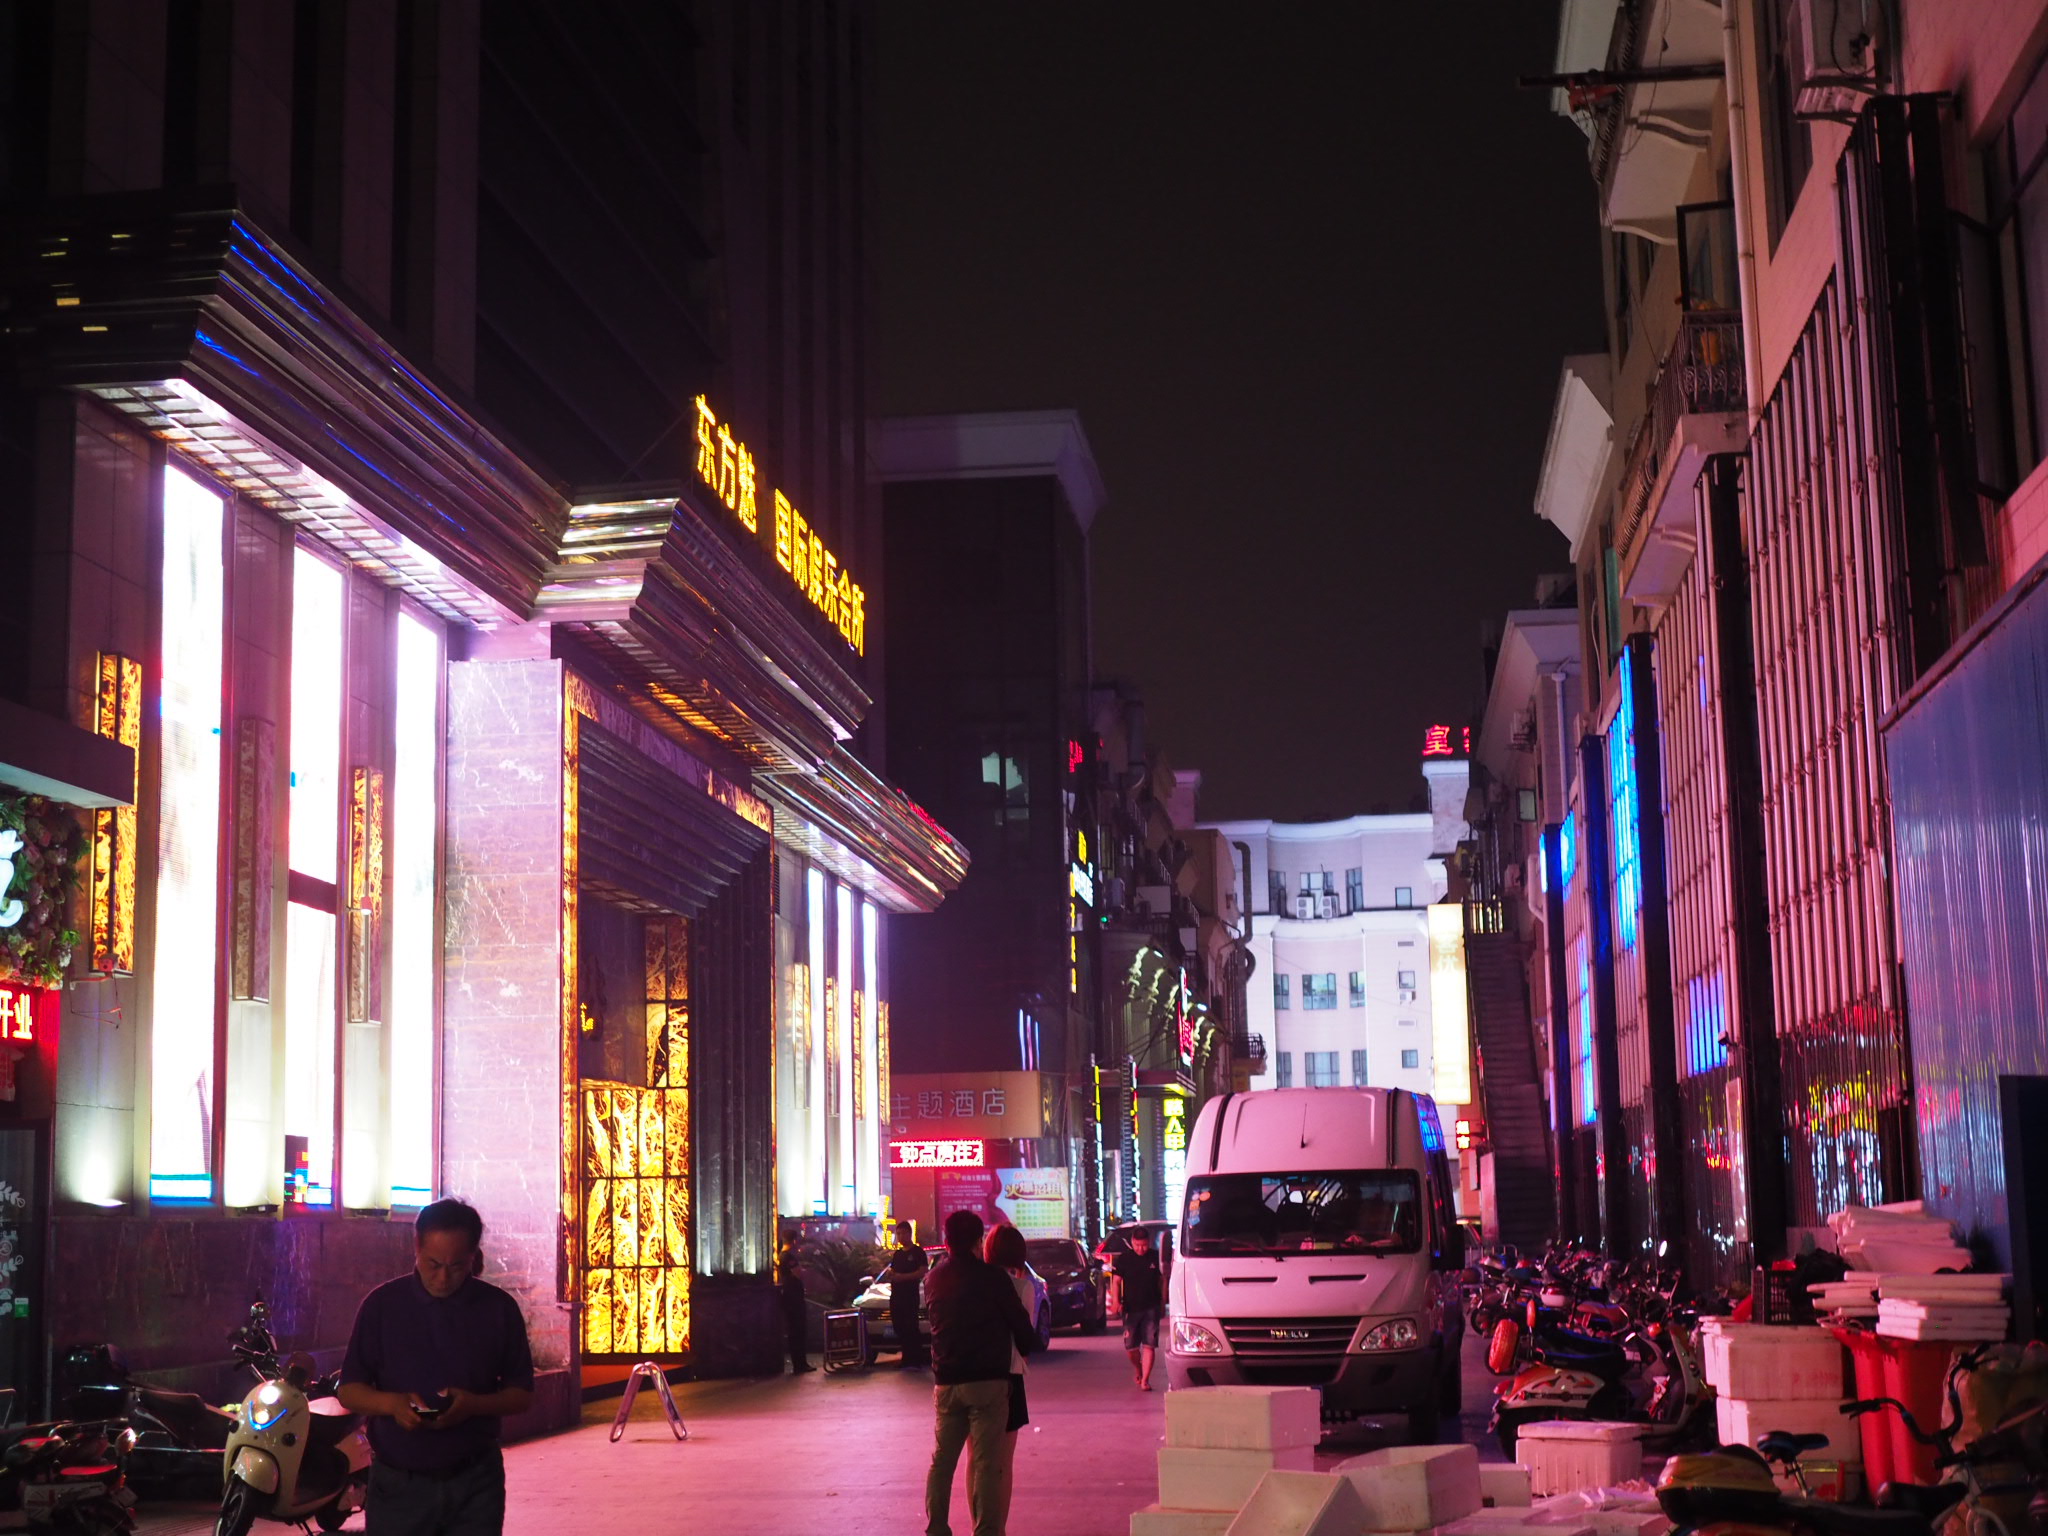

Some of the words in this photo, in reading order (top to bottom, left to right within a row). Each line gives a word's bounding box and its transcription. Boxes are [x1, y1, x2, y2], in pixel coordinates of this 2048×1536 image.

[774, 488, 865, 657] 国际娱乐会所
[891, 1088, 1006, 1120] 主题酒店
